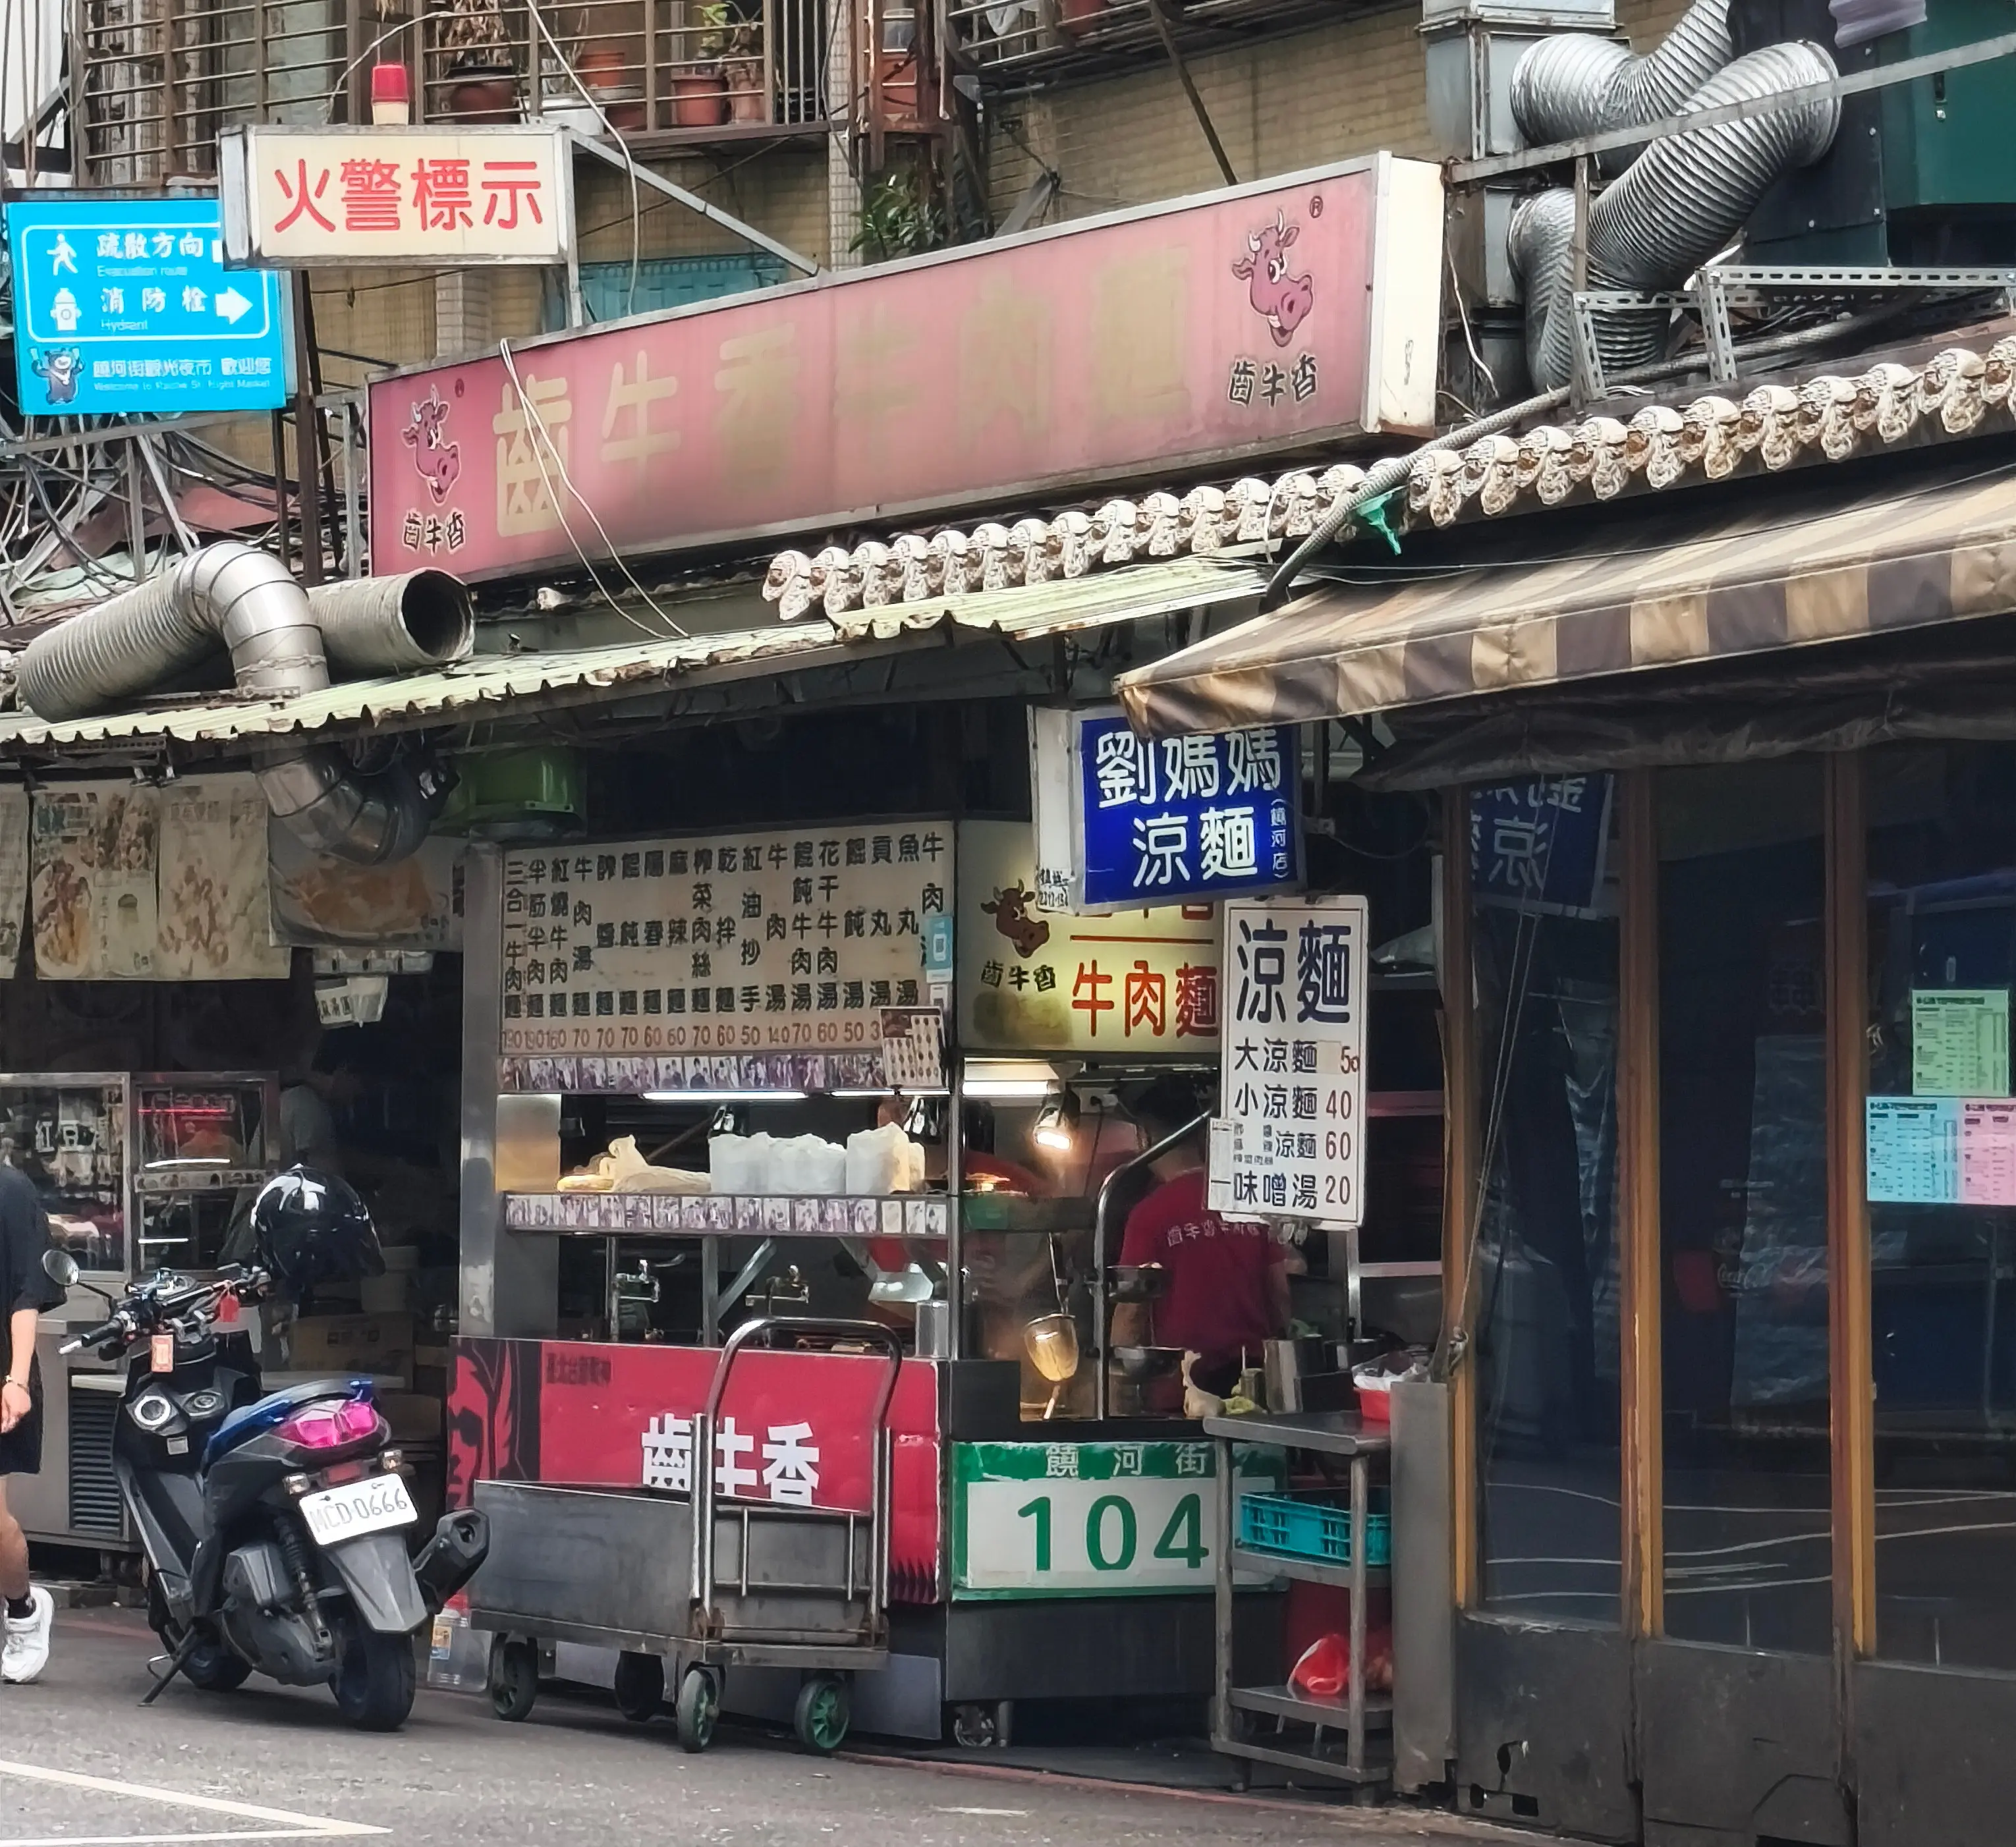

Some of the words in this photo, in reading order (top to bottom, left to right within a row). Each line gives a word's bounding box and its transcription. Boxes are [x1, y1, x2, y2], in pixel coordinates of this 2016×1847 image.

[273, 157, 544, 233] 火警標示
[97, 232, 204, 260] 疏散方向
[100, 285, 209, 314] 消防栓
[1096, 729, 1281, 808] 劉媽媽
[1133, 806, 1258, 888] 涼麵
[766, 843, 788, 1012] 牛肉湯
[817, 840, 841, 1010] 花干牛肉湯
[870, 836, 893, 1008] 貢丸湯
[896, 834, 920, 1006] 魚丸湯
[1071, 958, 1218, 1038] 牛肉麵
[1237, 918, 1351, 1024] 涼麵
[573, 1028, 590, 1048] 70
[596, 1027, 615, 1049] 70
[621, 1026, 638, 1047] 70
[644, 1026, 663, 1047] 60
[667, 1026, 686, 1047] 60
[692, 1025, 711, 1047] 70
[717, 1025, 735, 1046] 60
[740, 1025, 760, 1045] 50
[792, 1023, 812, 1043] 70
[817, 1022, 838, 1043] 60
[843, 1022, 864, 1042] 50
[1235, 1037, 1318, 1074] 大涼麵
[1235, 1082, 1318, 1120] 小涼麵
[1326, 1089, 1351, 1120] 40
[1275, 1130, 1317, 1159] 涼麵
[1326, 1131, 1351, 1161] 60
[1233, 1170, 1318, 1210] 味噌湯
[1326, 1174, 1351, 1205] 20
[642, 1412, 820, 1505] 齒牛香
[1045, 1443, 1208, 1477] 饒河街
[1017, 1493, 1210, 1571] 104
